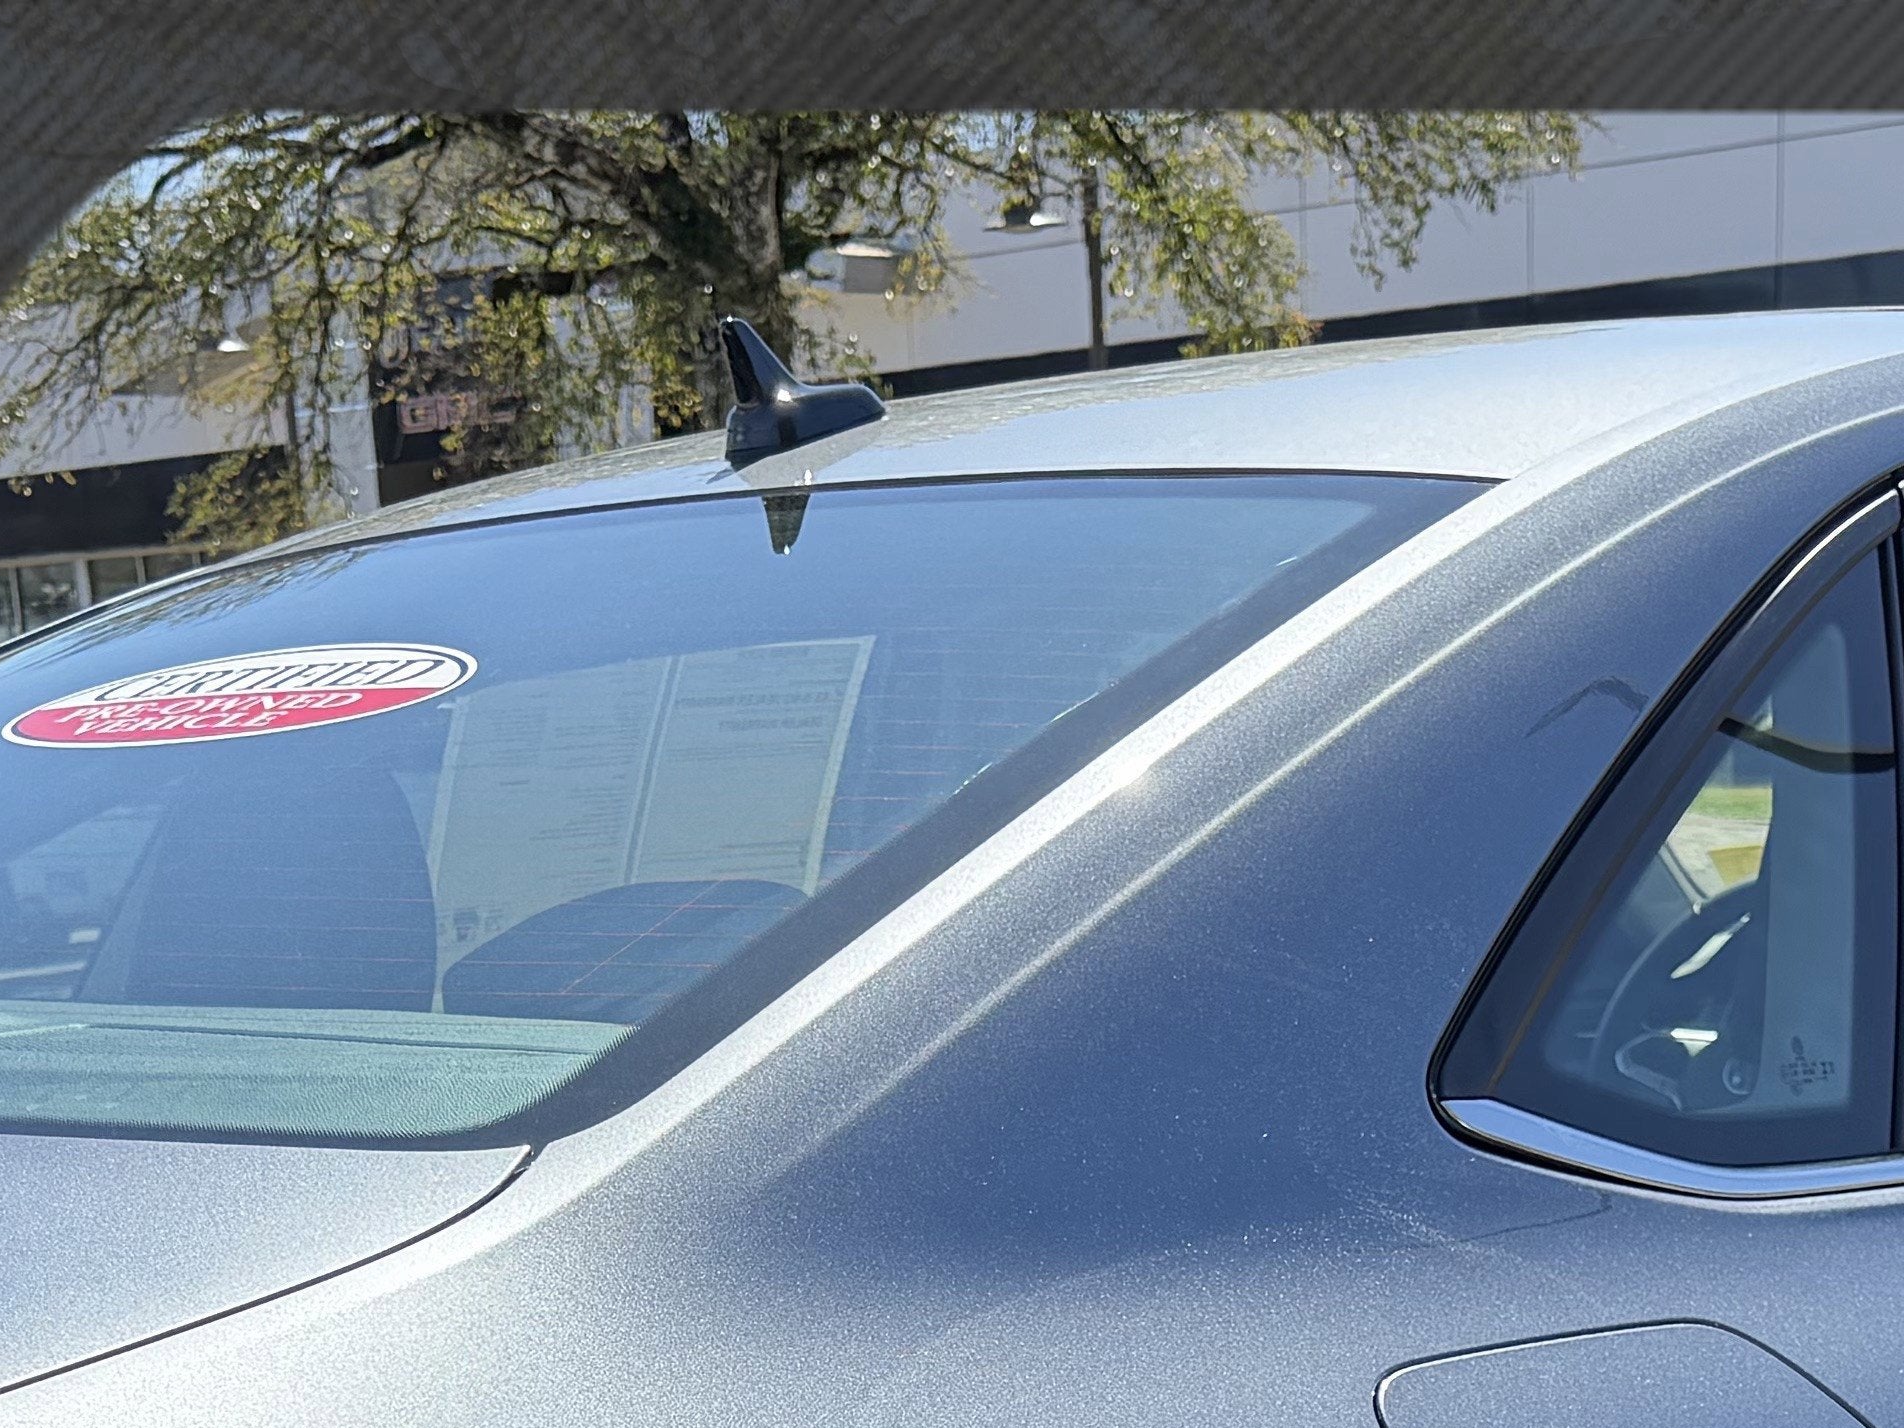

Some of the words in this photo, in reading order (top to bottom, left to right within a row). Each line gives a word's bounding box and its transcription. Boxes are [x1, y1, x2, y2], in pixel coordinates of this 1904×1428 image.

[96, 658, 446, 702] CERTIFIED
[54, 690, 363, 724] PRE-OWNED
[72, 711, 283, 737] VEHICLE
